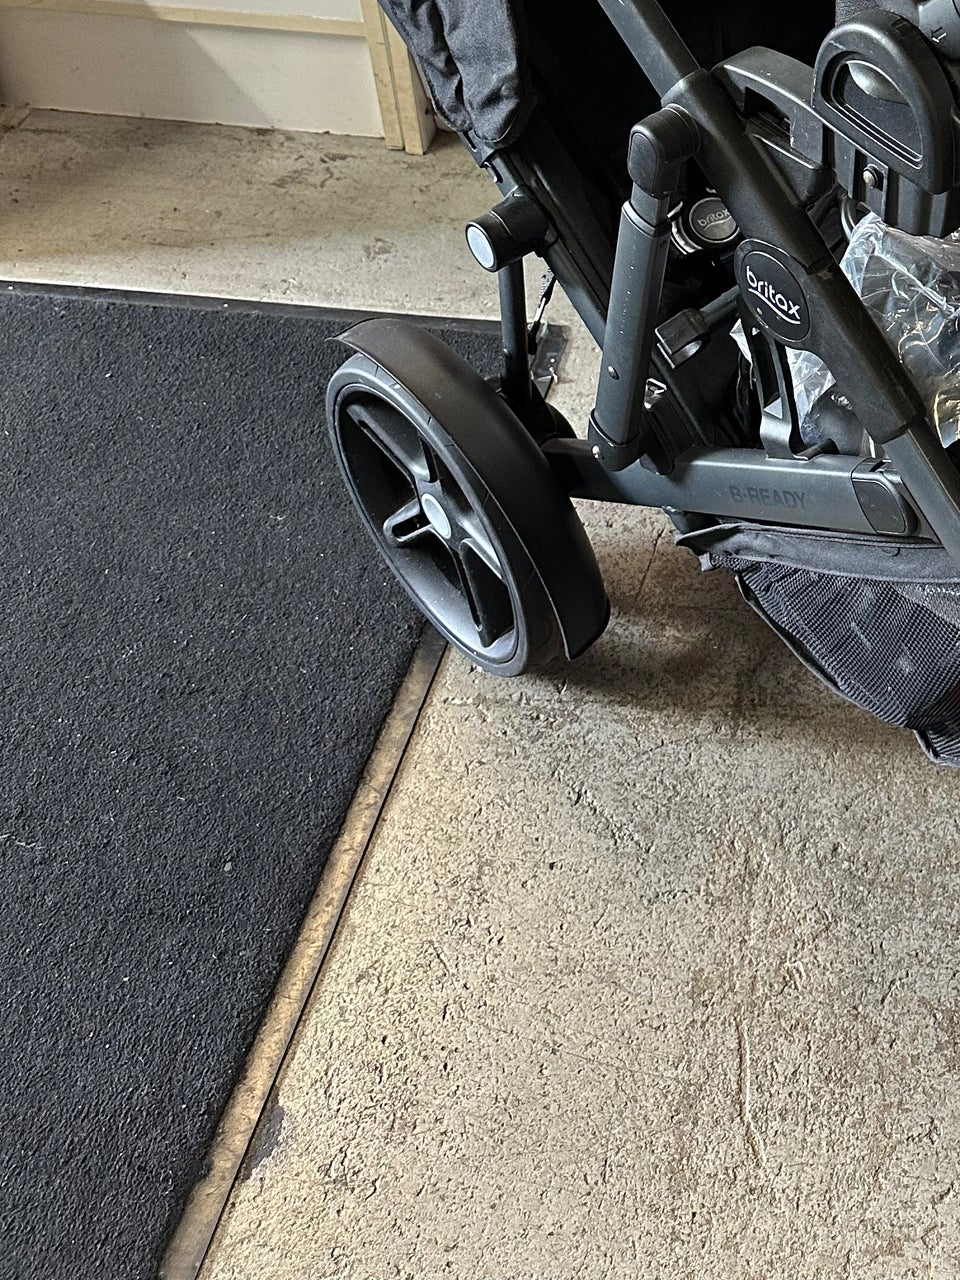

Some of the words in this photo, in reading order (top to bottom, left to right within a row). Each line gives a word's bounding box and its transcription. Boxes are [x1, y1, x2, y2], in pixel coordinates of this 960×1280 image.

[697, 208, 730, 227] britax
[746, 265, 801, 320] britax
[729, 484, 806, 511] B-READY
